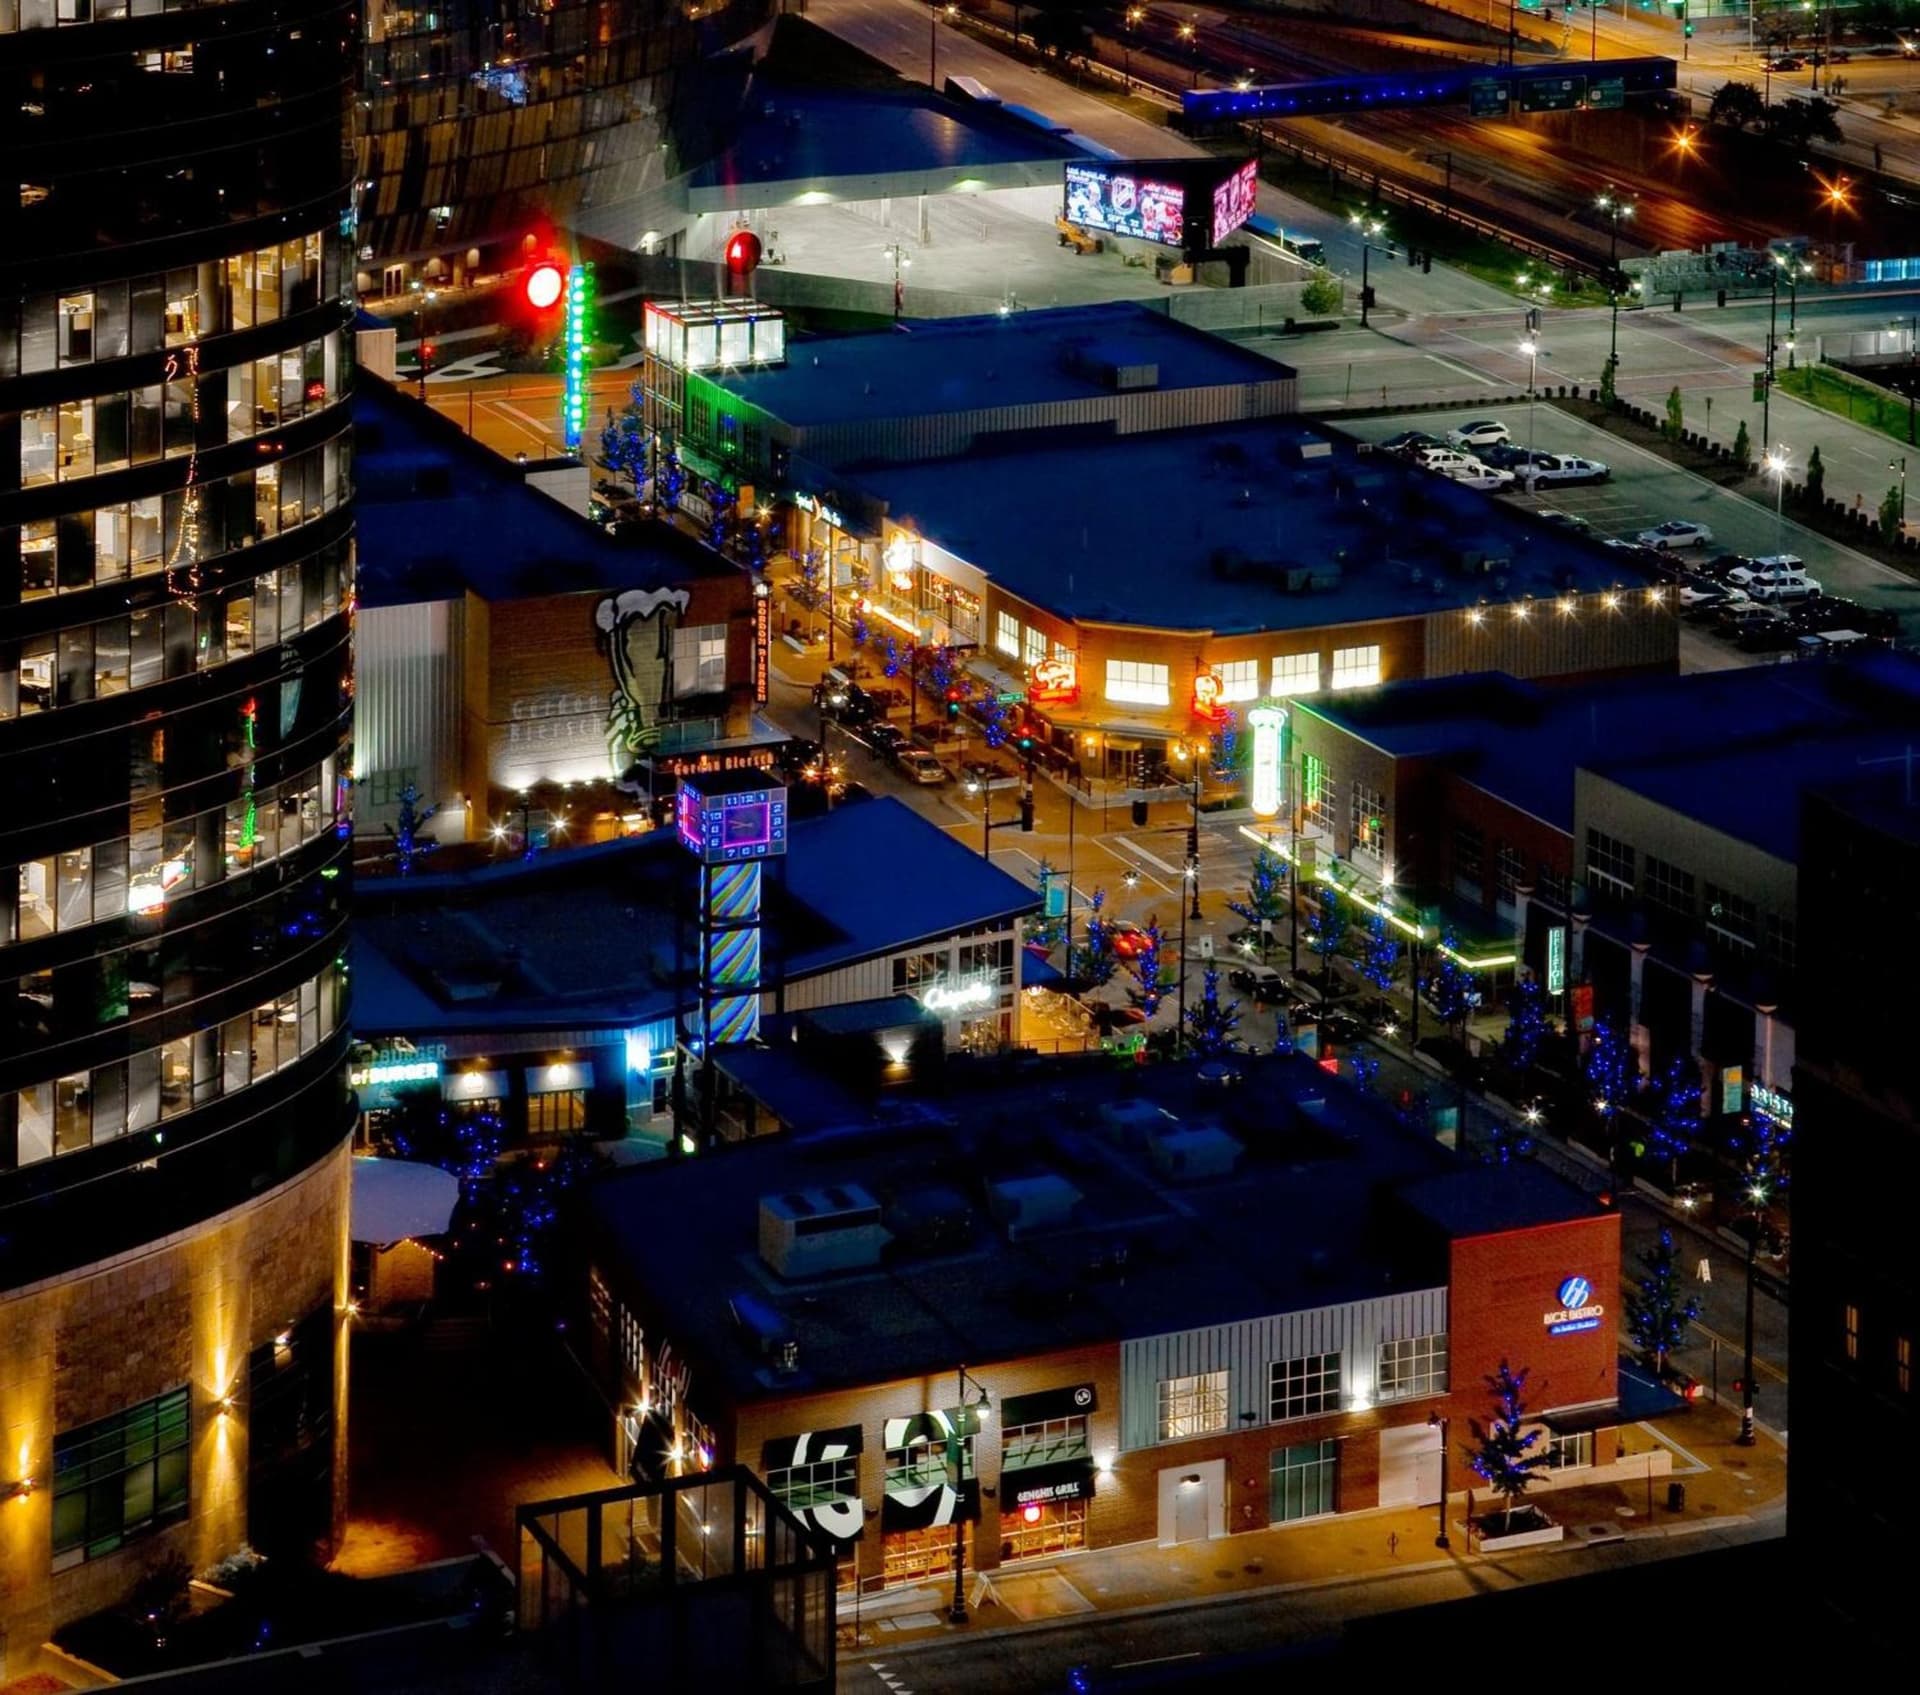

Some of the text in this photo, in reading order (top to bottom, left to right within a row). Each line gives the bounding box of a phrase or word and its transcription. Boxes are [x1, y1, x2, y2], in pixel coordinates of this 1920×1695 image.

[757, 599, 767, 702] GORDON BIERSCH
[725, 751, 774, 770] Biersch
